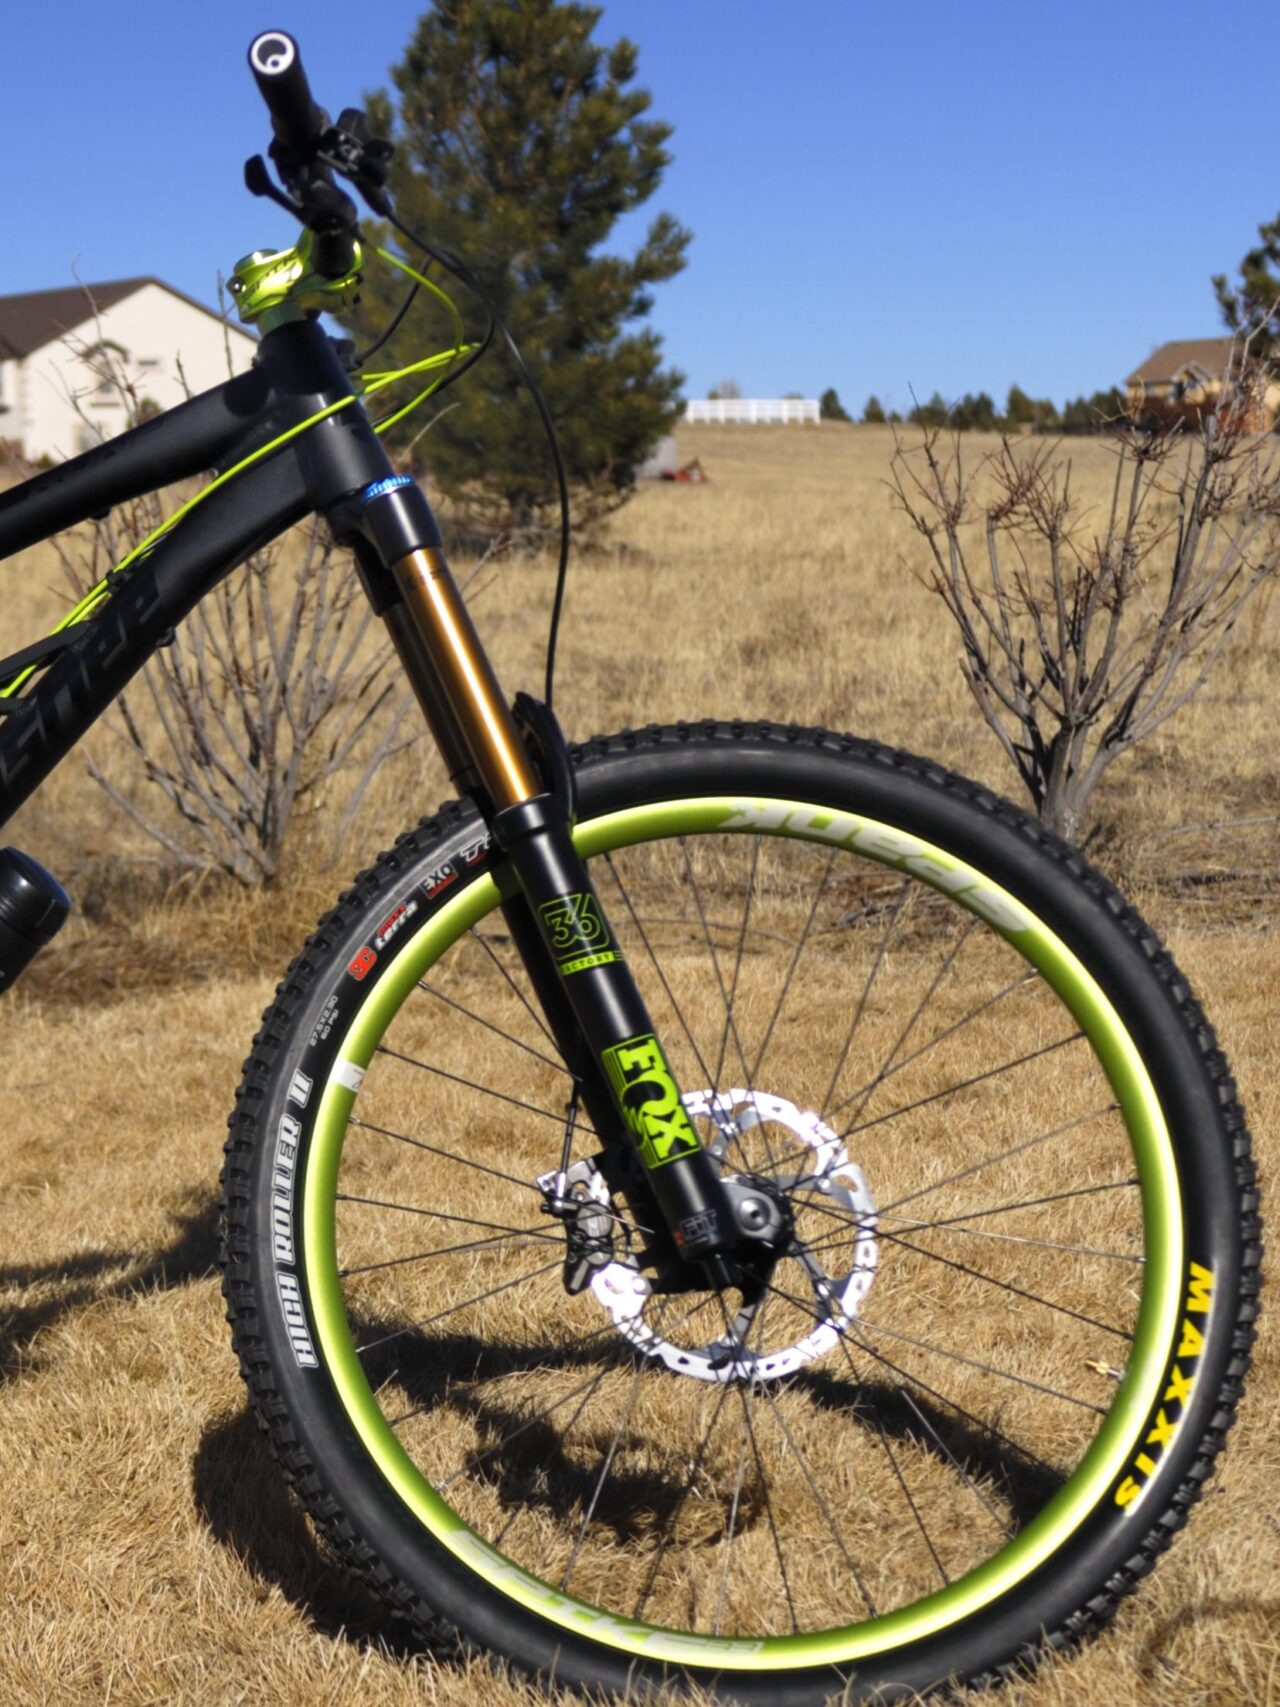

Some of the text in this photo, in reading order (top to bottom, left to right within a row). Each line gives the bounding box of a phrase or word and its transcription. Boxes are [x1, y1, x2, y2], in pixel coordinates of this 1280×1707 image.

[421, 863, 453, 892] EXO
[543, 893, 601, 948] 36
[347, 945, 378, 982] 3C
[617, 1039, 698, 1161] FOX
[271, 1068, 319, 1368] HIGH ROLLER II
[1114, 1261, 1217, 1518] MAXXIS
